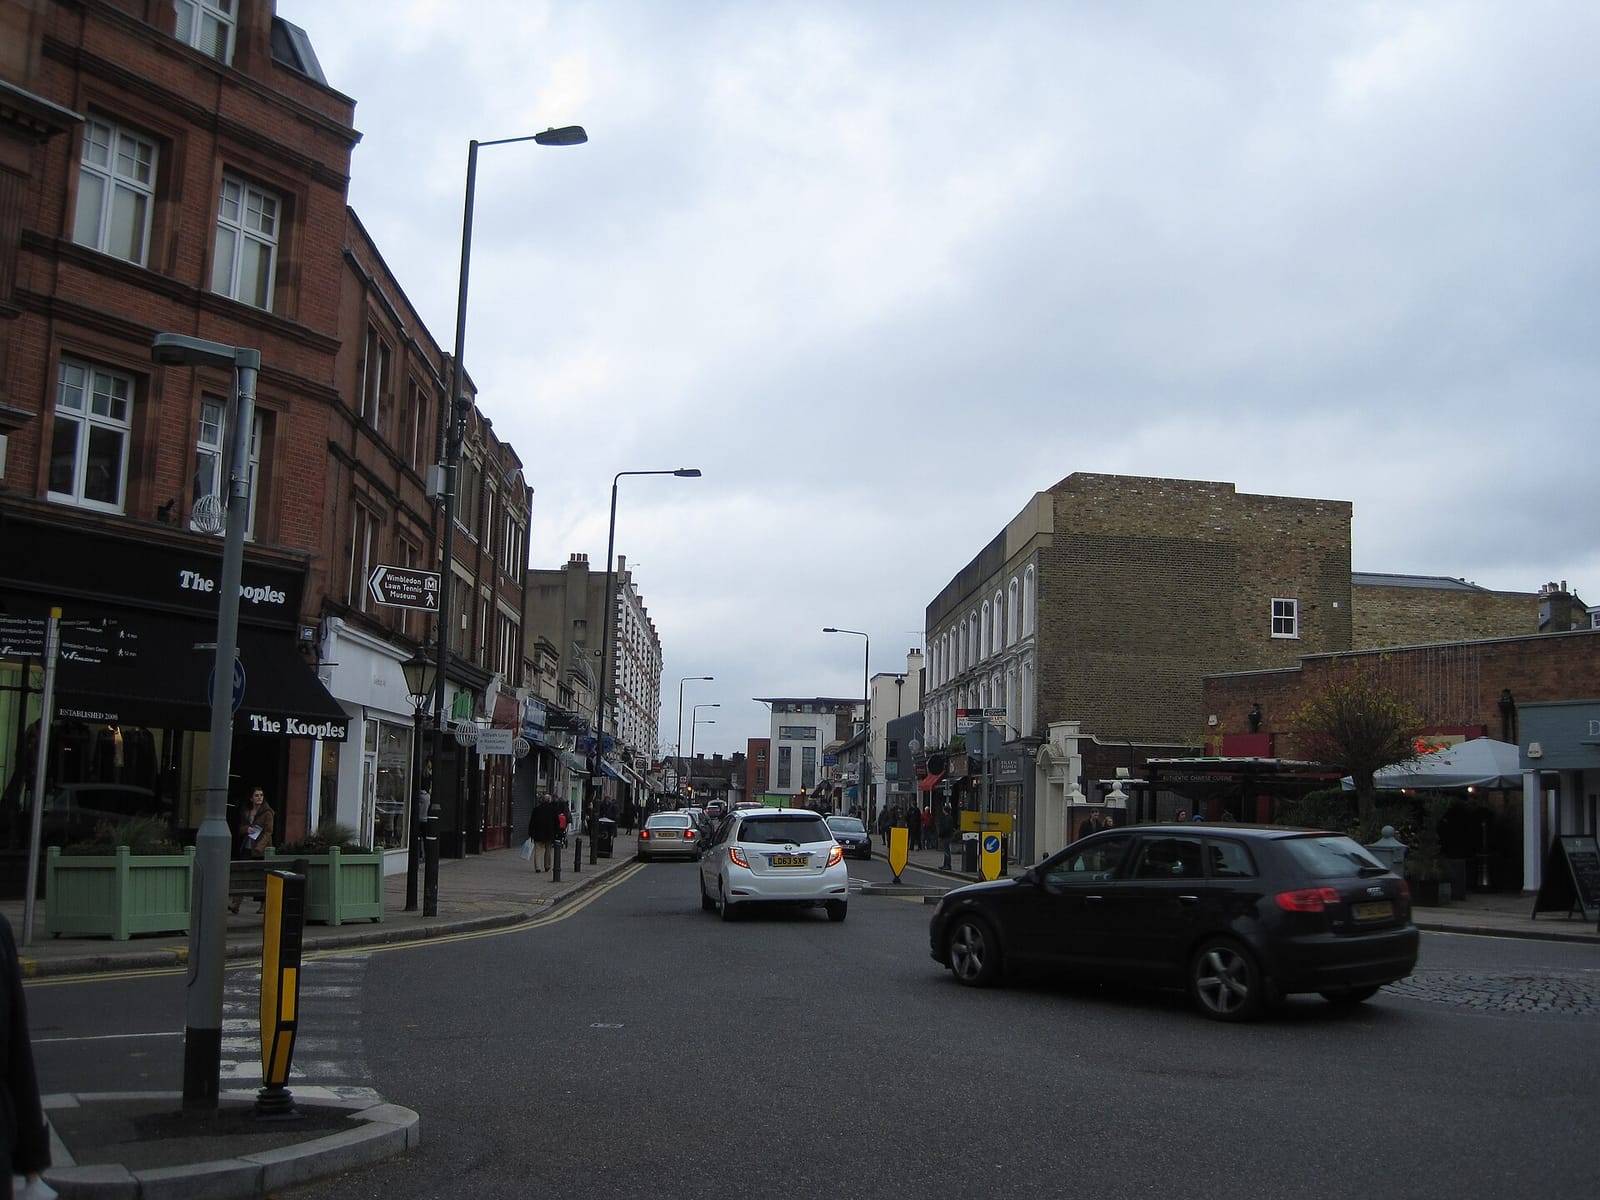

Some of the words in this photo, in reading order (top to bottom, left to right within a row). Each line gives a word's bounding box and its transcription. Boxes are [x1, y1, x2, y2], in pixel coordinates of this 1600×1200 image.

[386, 574, 422, 585] Wimbledon
[180, 570, 215, 593] The
[219, 582, 286, 604] oples
[384, 582, 401, 591] Lawn
[402, 584, 422, 594] Tennis
[390, 591, 417, 601] Museum
[60, 708, 104, 719] ESTABLISHED
[250, 714, 280, 733] The
[285, 718, 345, 740] Kooples
[773, 857, 792, 865] LD63
[793, 857, 808, 865] SXE
